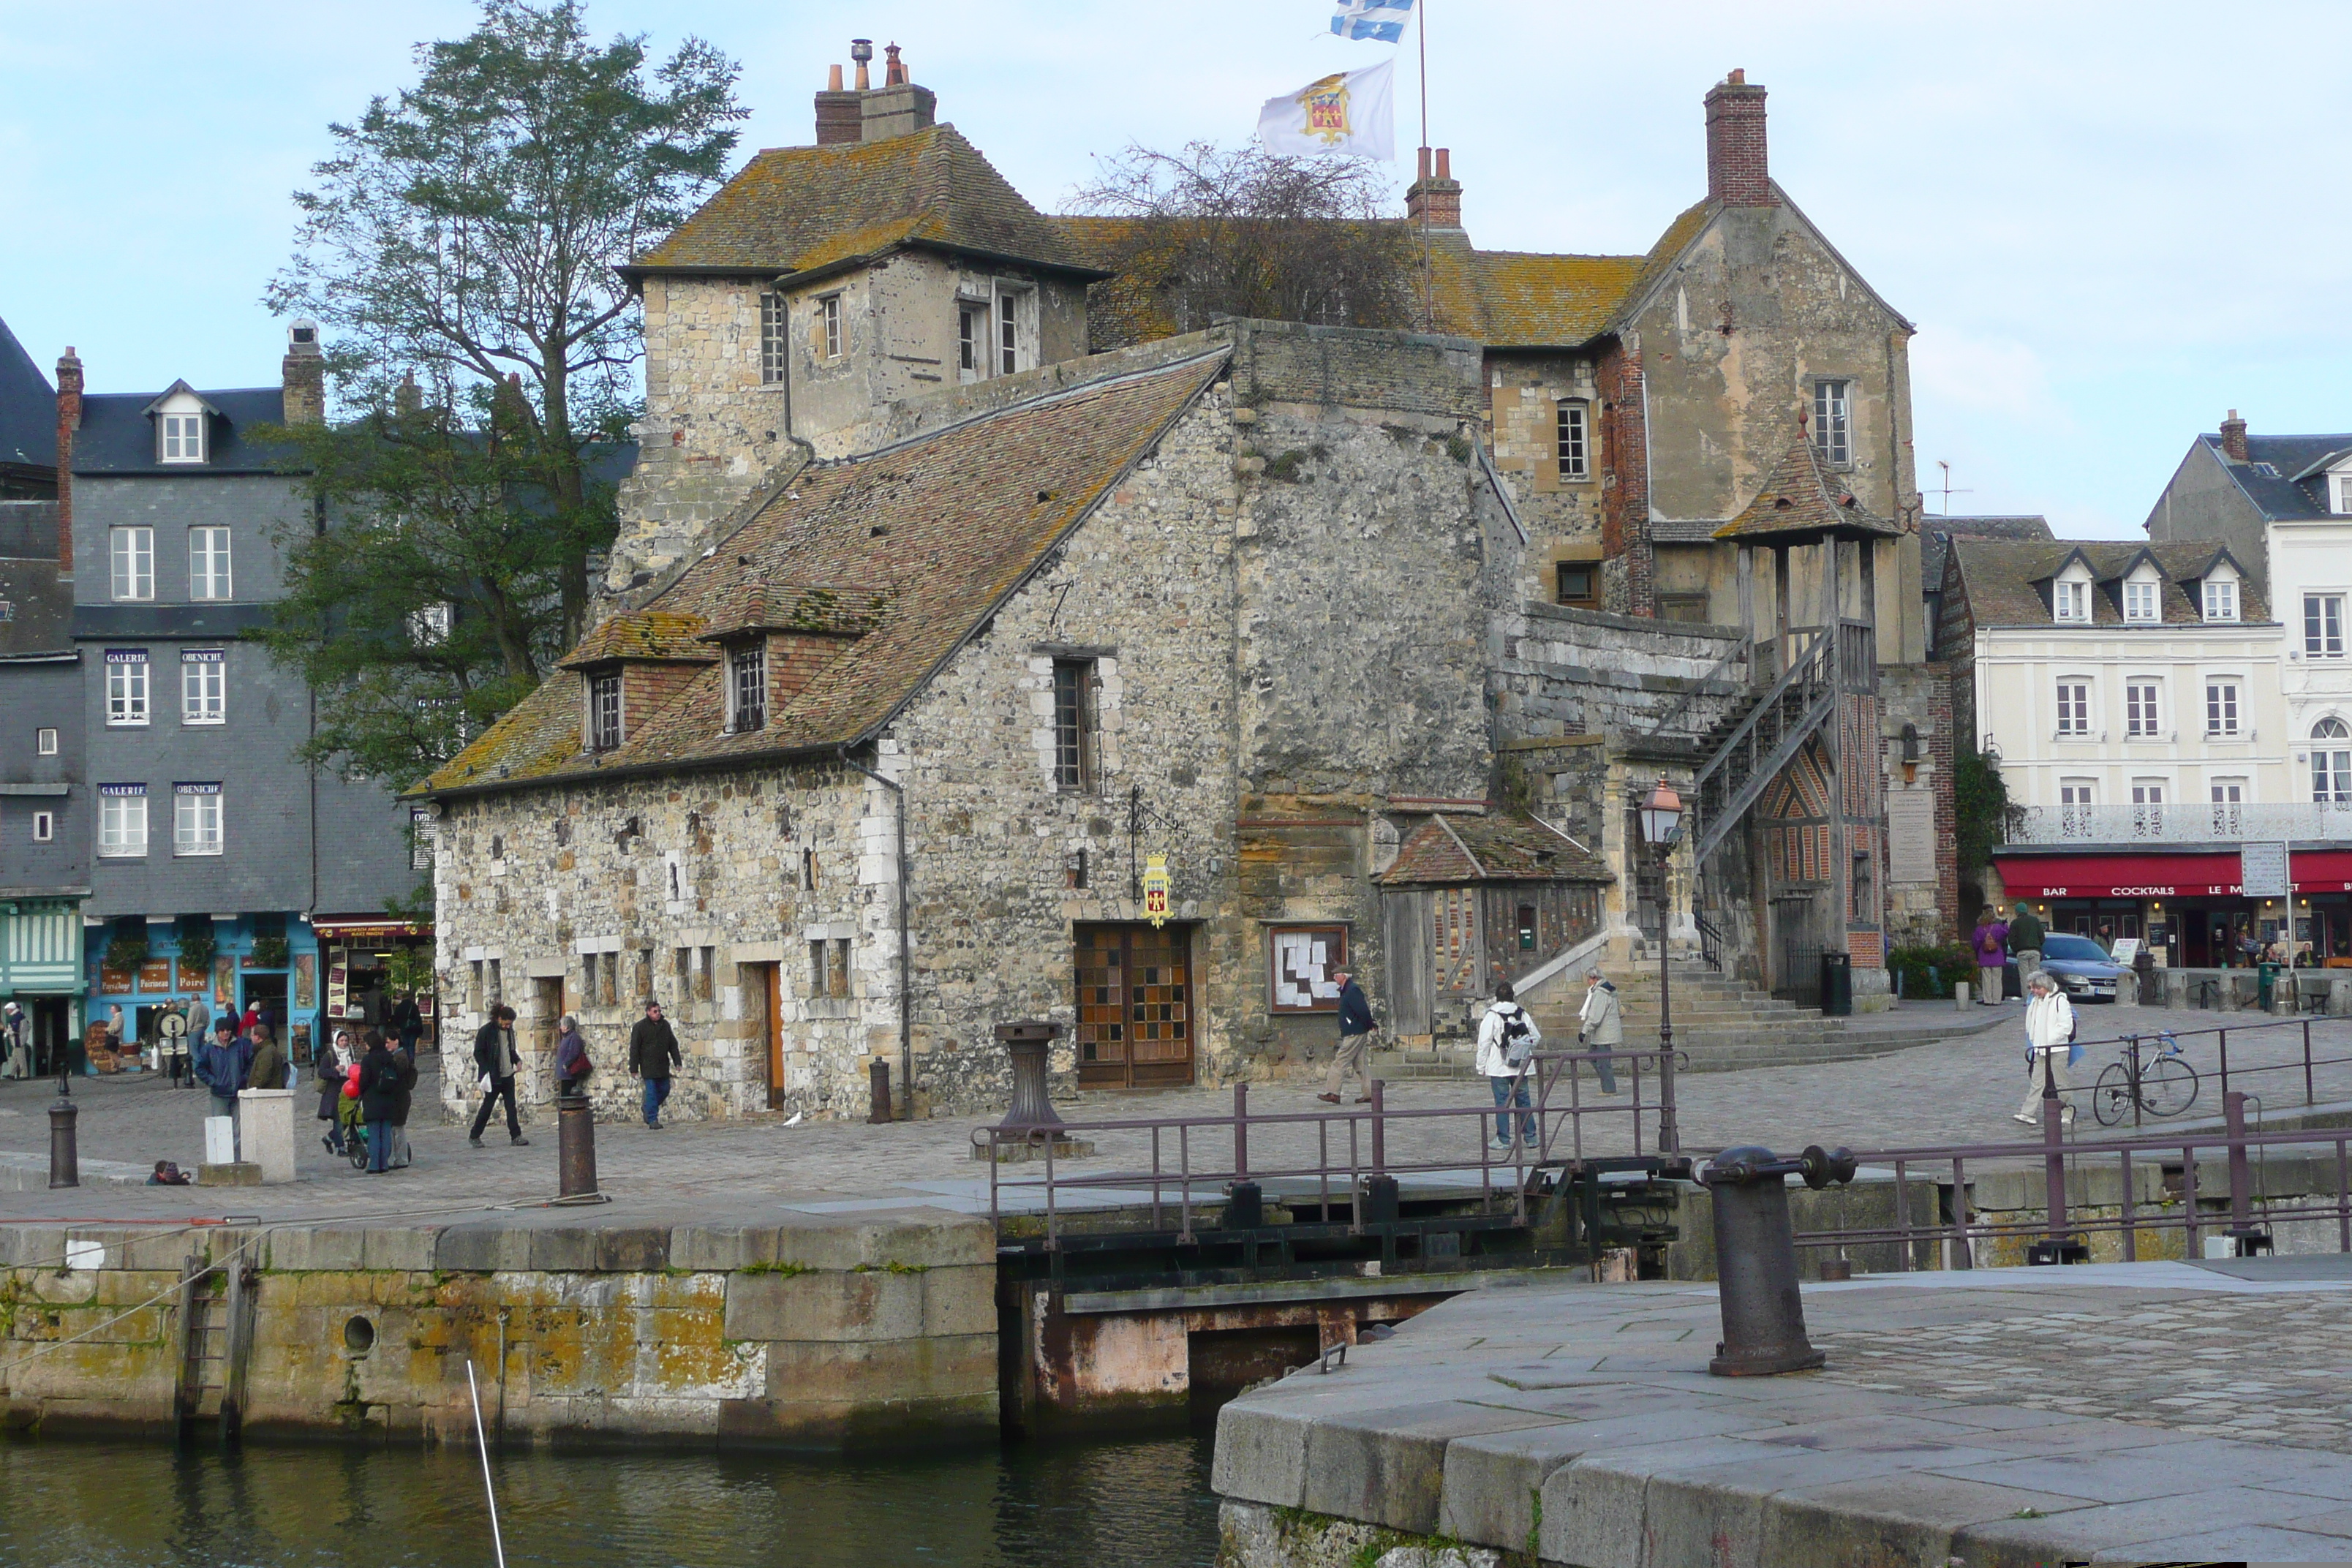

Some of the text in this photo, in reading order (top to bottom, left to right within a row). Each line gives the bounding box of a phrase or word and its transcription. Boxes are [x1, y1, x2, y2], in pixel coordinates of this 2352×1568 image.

[107, 654, 147, 663] GALERIE
[182, 653, 222, 661] OBENICHE
[102, 786, 145, 795] GALERIE
[177, 785, 219, 794] OBENICHE
[2043, 887, 2067, 896] BAR
[2111, 886, 2175, 896] COCKTAILS
